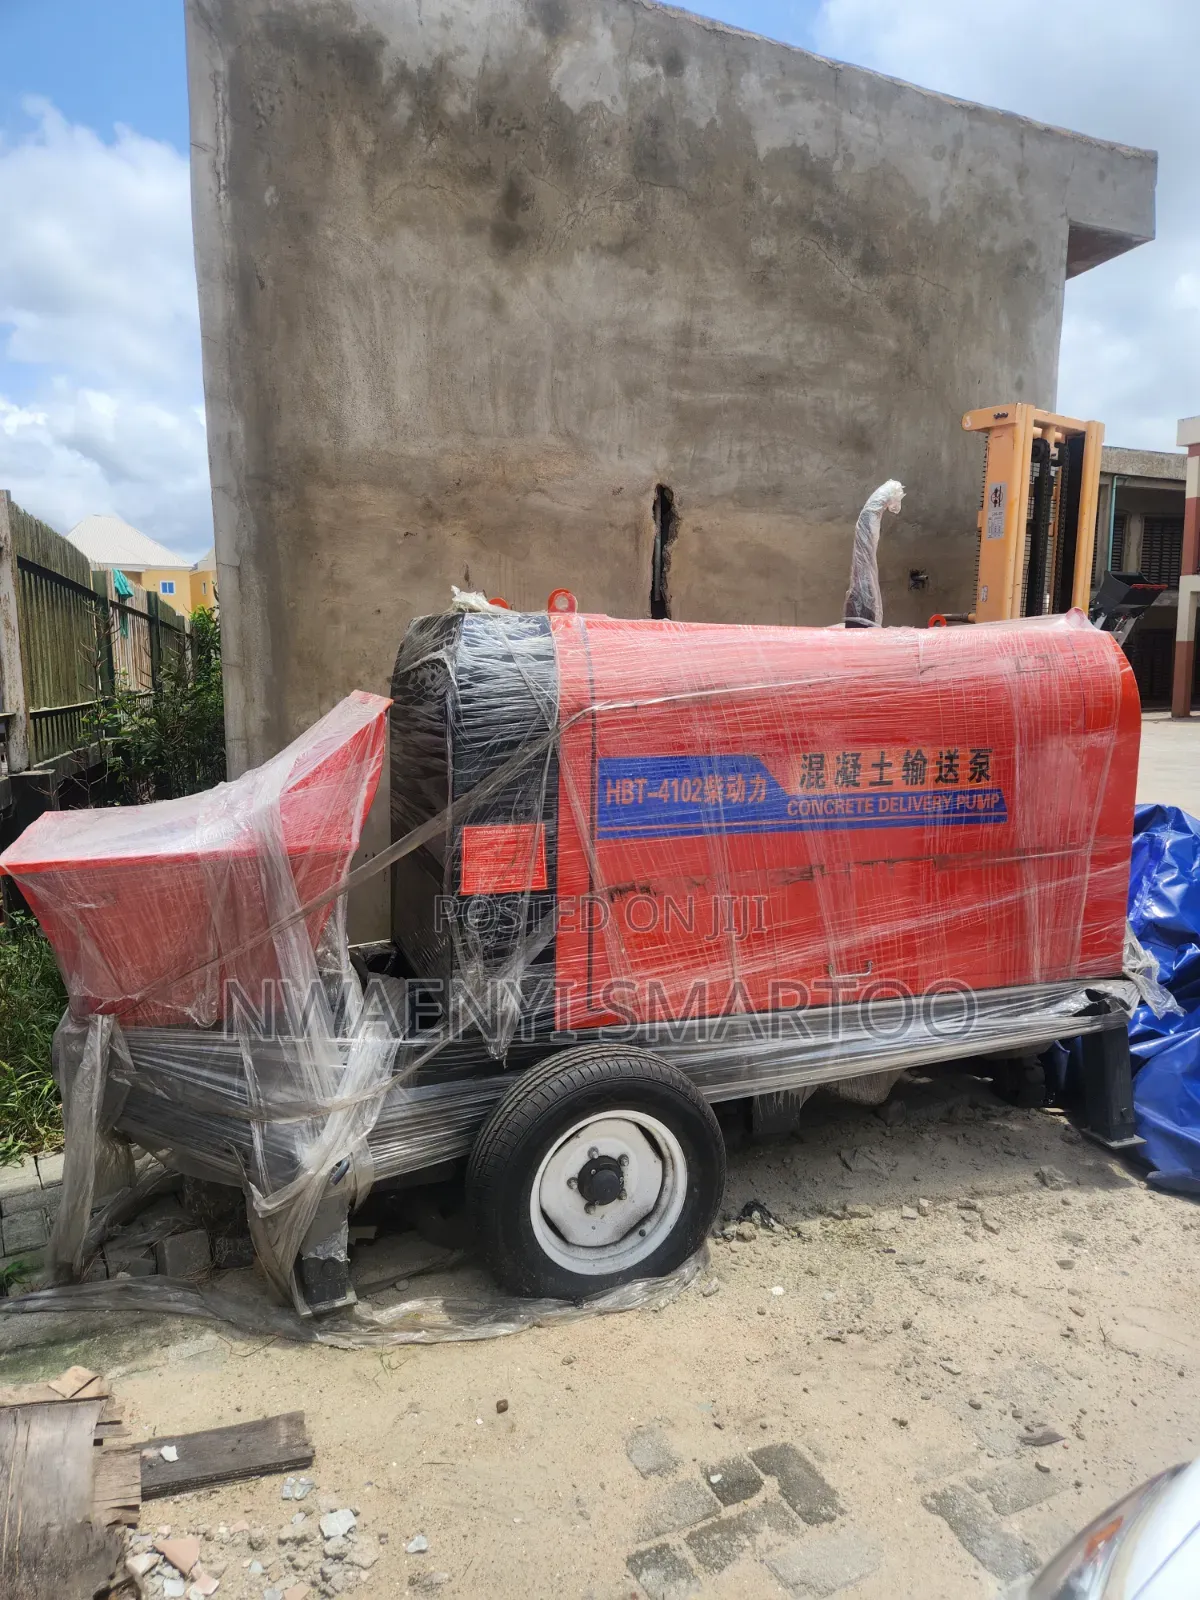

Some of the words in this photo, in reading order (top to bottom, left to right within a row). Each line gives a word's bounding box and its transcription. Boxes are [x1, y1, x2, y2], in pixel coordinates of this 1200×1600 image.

[799, 748, 993, 789] 混凝土输送泵
[787, 797, 874, 817] CONCRETE
[878, 795, 953, 813] DELIVERY
[956, 793, 1000, 810] PUMP
